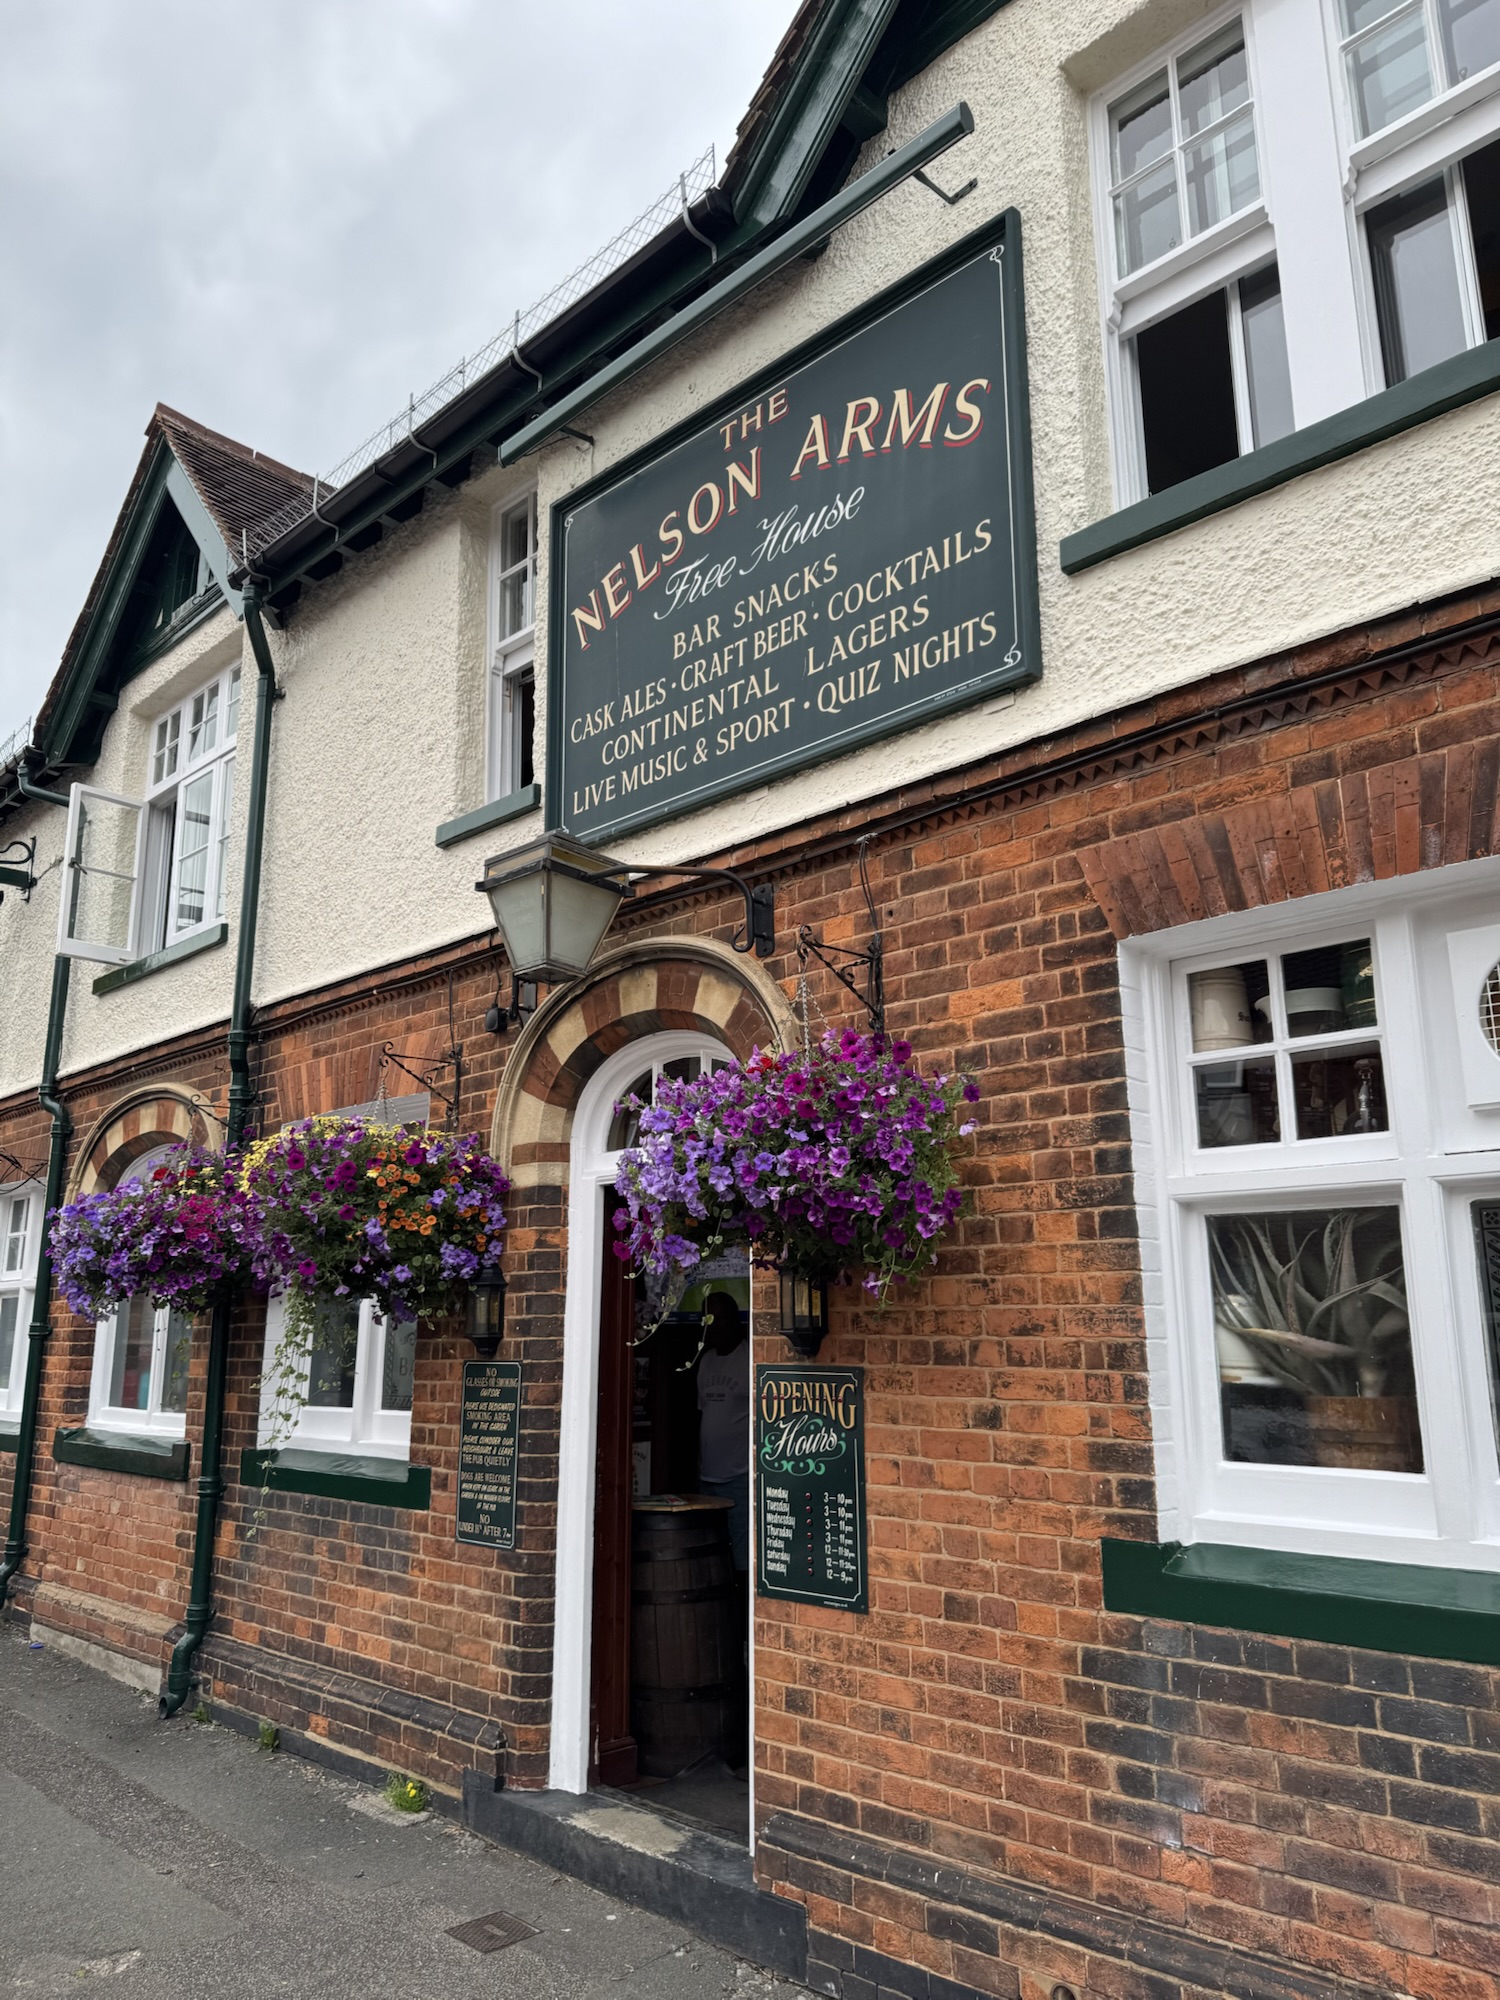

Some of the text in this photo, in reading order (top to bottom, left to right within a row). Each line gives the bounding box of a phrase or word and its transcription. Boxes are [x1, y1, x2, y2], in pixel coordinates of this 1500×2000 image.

[720, 388, 790, 451] THE
[571, 378, 991, 651] NELSON ARMS
[654, 486, 865, 620] Free House
[673, 553, 838, 660] BAR SNACKS
[570, 518, 992, 744] CASK ALES CRAFT BEER COCKTAILS
[602, 594, 929, 766] CONTINENTAL LAGERS
[573, 775, 616, 815] LIVE
[621, 746, 688, 796] MUSIC
[692, 737, 708, 765] &
[716, 698, 796, 756] SPORT
[817, 660, 881, 714] QUIZ
[892, 611, 997, 684] NIGHTS
[486, 1367, 497, 1377] NO
[762, 1381, 856, 1429] OPENING
[466, 1411, 511, 1422] SMOKING AREA
[479, 1422, 489, 1430] THE
[765, 1415, 838, 1460] Hours
[498, 1447, 514, 1456] LEAVE
[463, 1454, 511, 1466] THE PUB QUIETLY
[461, 1471, 511, 1484] DOGS ARE WELCOME
[766, 1487, 788, 1502] Monday
[766, 1500, 790, 1516] Tuesday
[480, 1514, 490, 1524] NO
[766, 1513, 796, 1529] Wednesday
[459, 1521, 474, 1533] UNDER
[483, 1525, 501, 1536] AFTER
[766, 1525, 792, 1540] Thursday
[766, 1536, 784, 1550] Friday
[766, 1561, 786, 1576] Sunday
